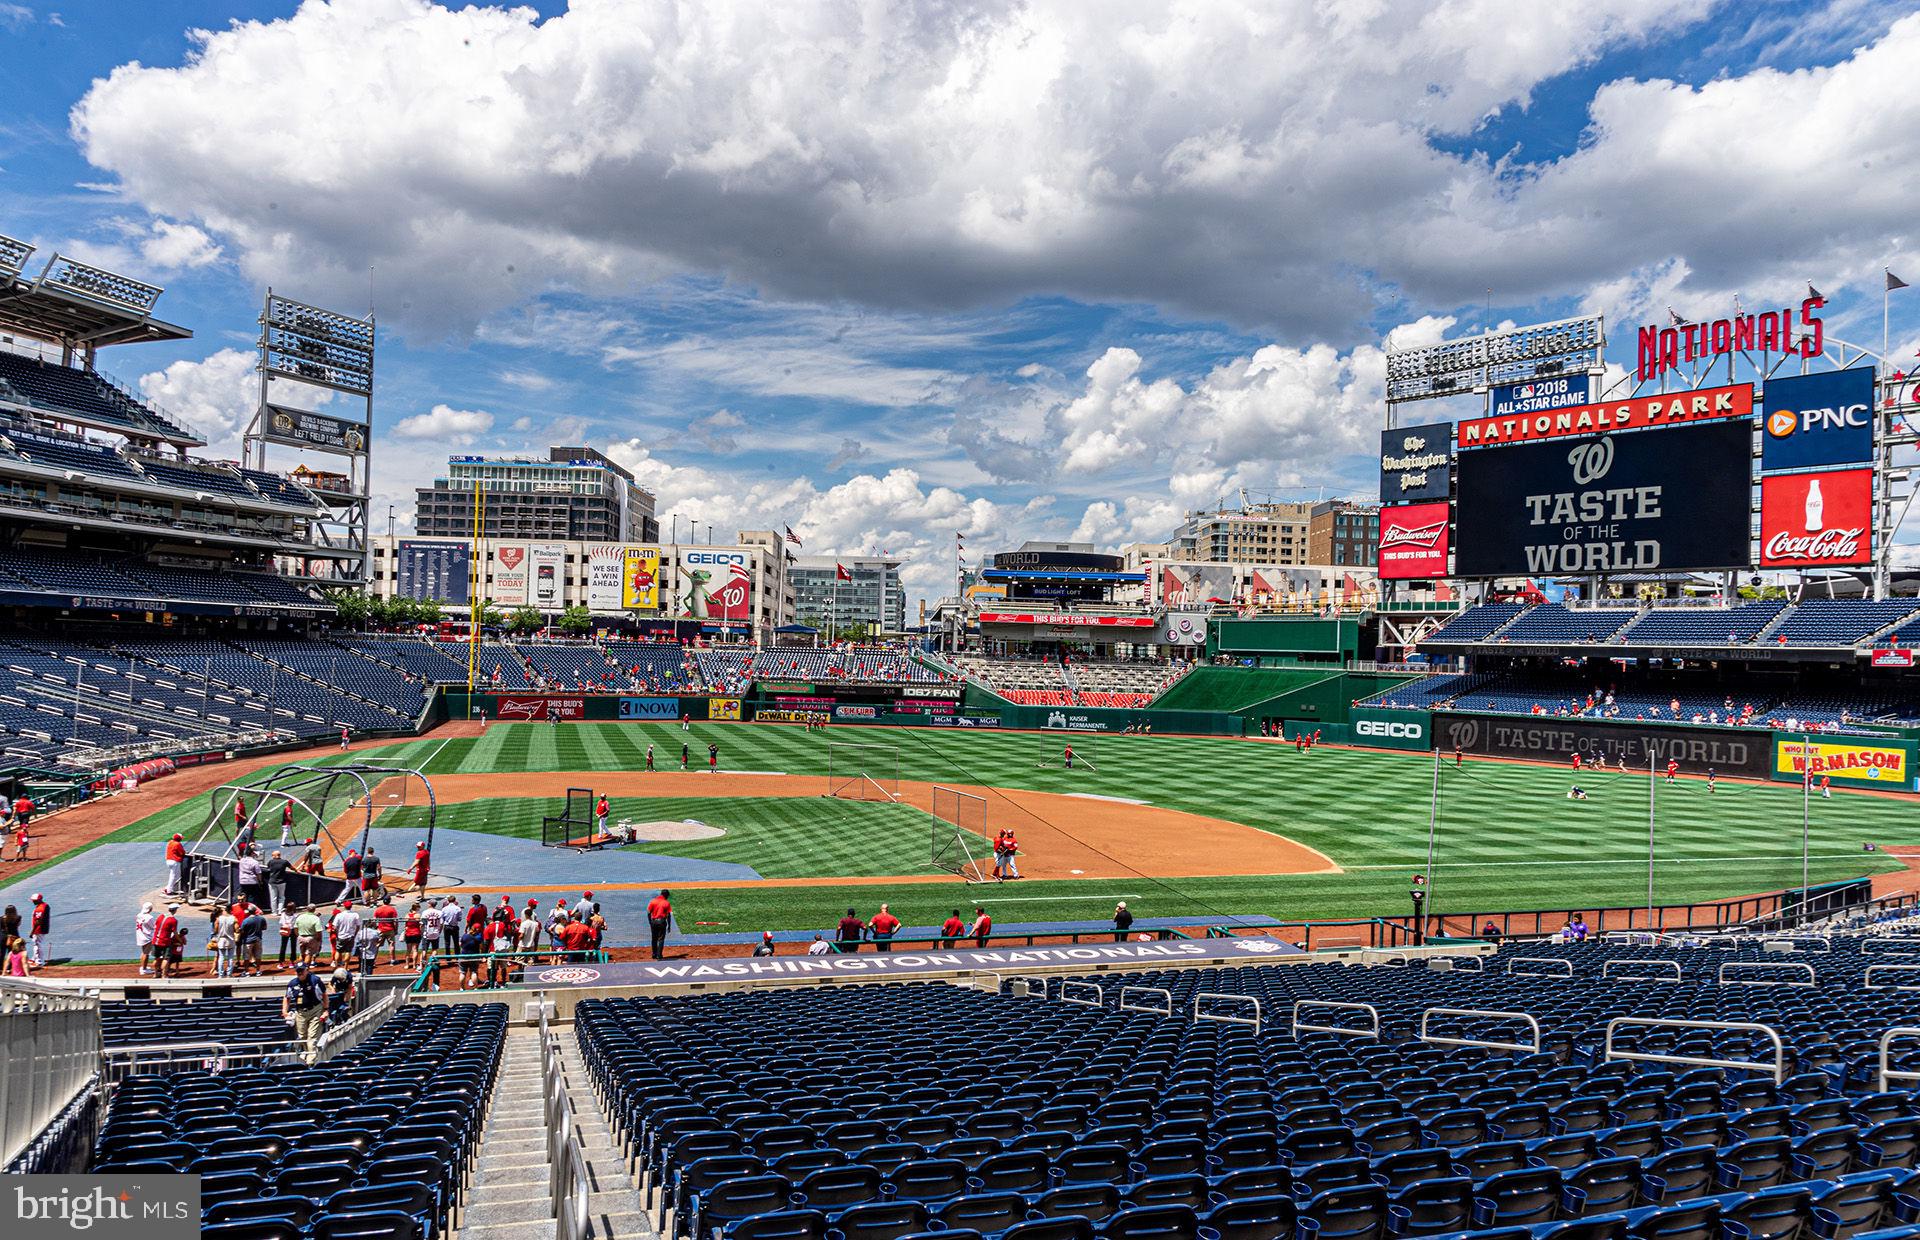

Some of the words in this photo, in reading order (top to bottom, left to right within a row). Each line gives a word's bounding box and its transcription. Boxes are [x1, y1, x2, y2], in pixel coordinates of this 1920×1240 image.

[1638, 296, 1823, 381] NATIONALS
[1536, 380, 1568, 397] 2018
[1551, 391, 1585, 407] GAME
[1466, 405, 1630, 440] NATIONALS
[1648, 392, 1733, 418] PARK
[1800, 404, 1869, 432] PNC
[294, 428, 309, 439] LEFT
[309, 431, 326, 442] FIELD
[326, 434, 344, 446] LODGE
[1403, 436, 1425, 451] The
[1382, 453, 1448, 472] Washington
[1400, 472, 1427, 490] Post
[1525, 485, 1662, 526] TASTE
[1385, 529, 1439, 543] Budweiser
[1563, 526, 1583, 541] OF
[1588, 523, 1620, 539] THE
[1765, 526, 1865, 561] Coca-Cola
[687, 553, 744, 565] GEICO
[1002, 553, 1040, 564] WORLD
[1383, 552, 1397, 560] THIS
[1397, 551, 1415, 560] BUD'S
[1428, 550, 1442, 558] YOU.
[1524, 539, 1661, 573] WORLD
[85, 598, 114, 608] TASTE
[135, 601, 167, 611] WORLD
[246, 608, 272, 616] TASTE
[289, 610, 316, 618] WORLD
[1667, 648, 1702, 658] TASTE
[1729, 649, 1772, 659] WORLD
[933, 689, 960, 697] FAN
[635, 702, 677, 714] INOVA
[1356, 720, 1422, 738] GEICO
[1495, 727, 1575, 751] TASTE
[1578, 737, 1600, 752] OF
[1606, 739, 1637, 756] THE
[1640, 736, 1748, 765] WORLD
[644, 956, 961, 978] WASHINGTON
[974, 944, 1206, 964] NATIONALS
